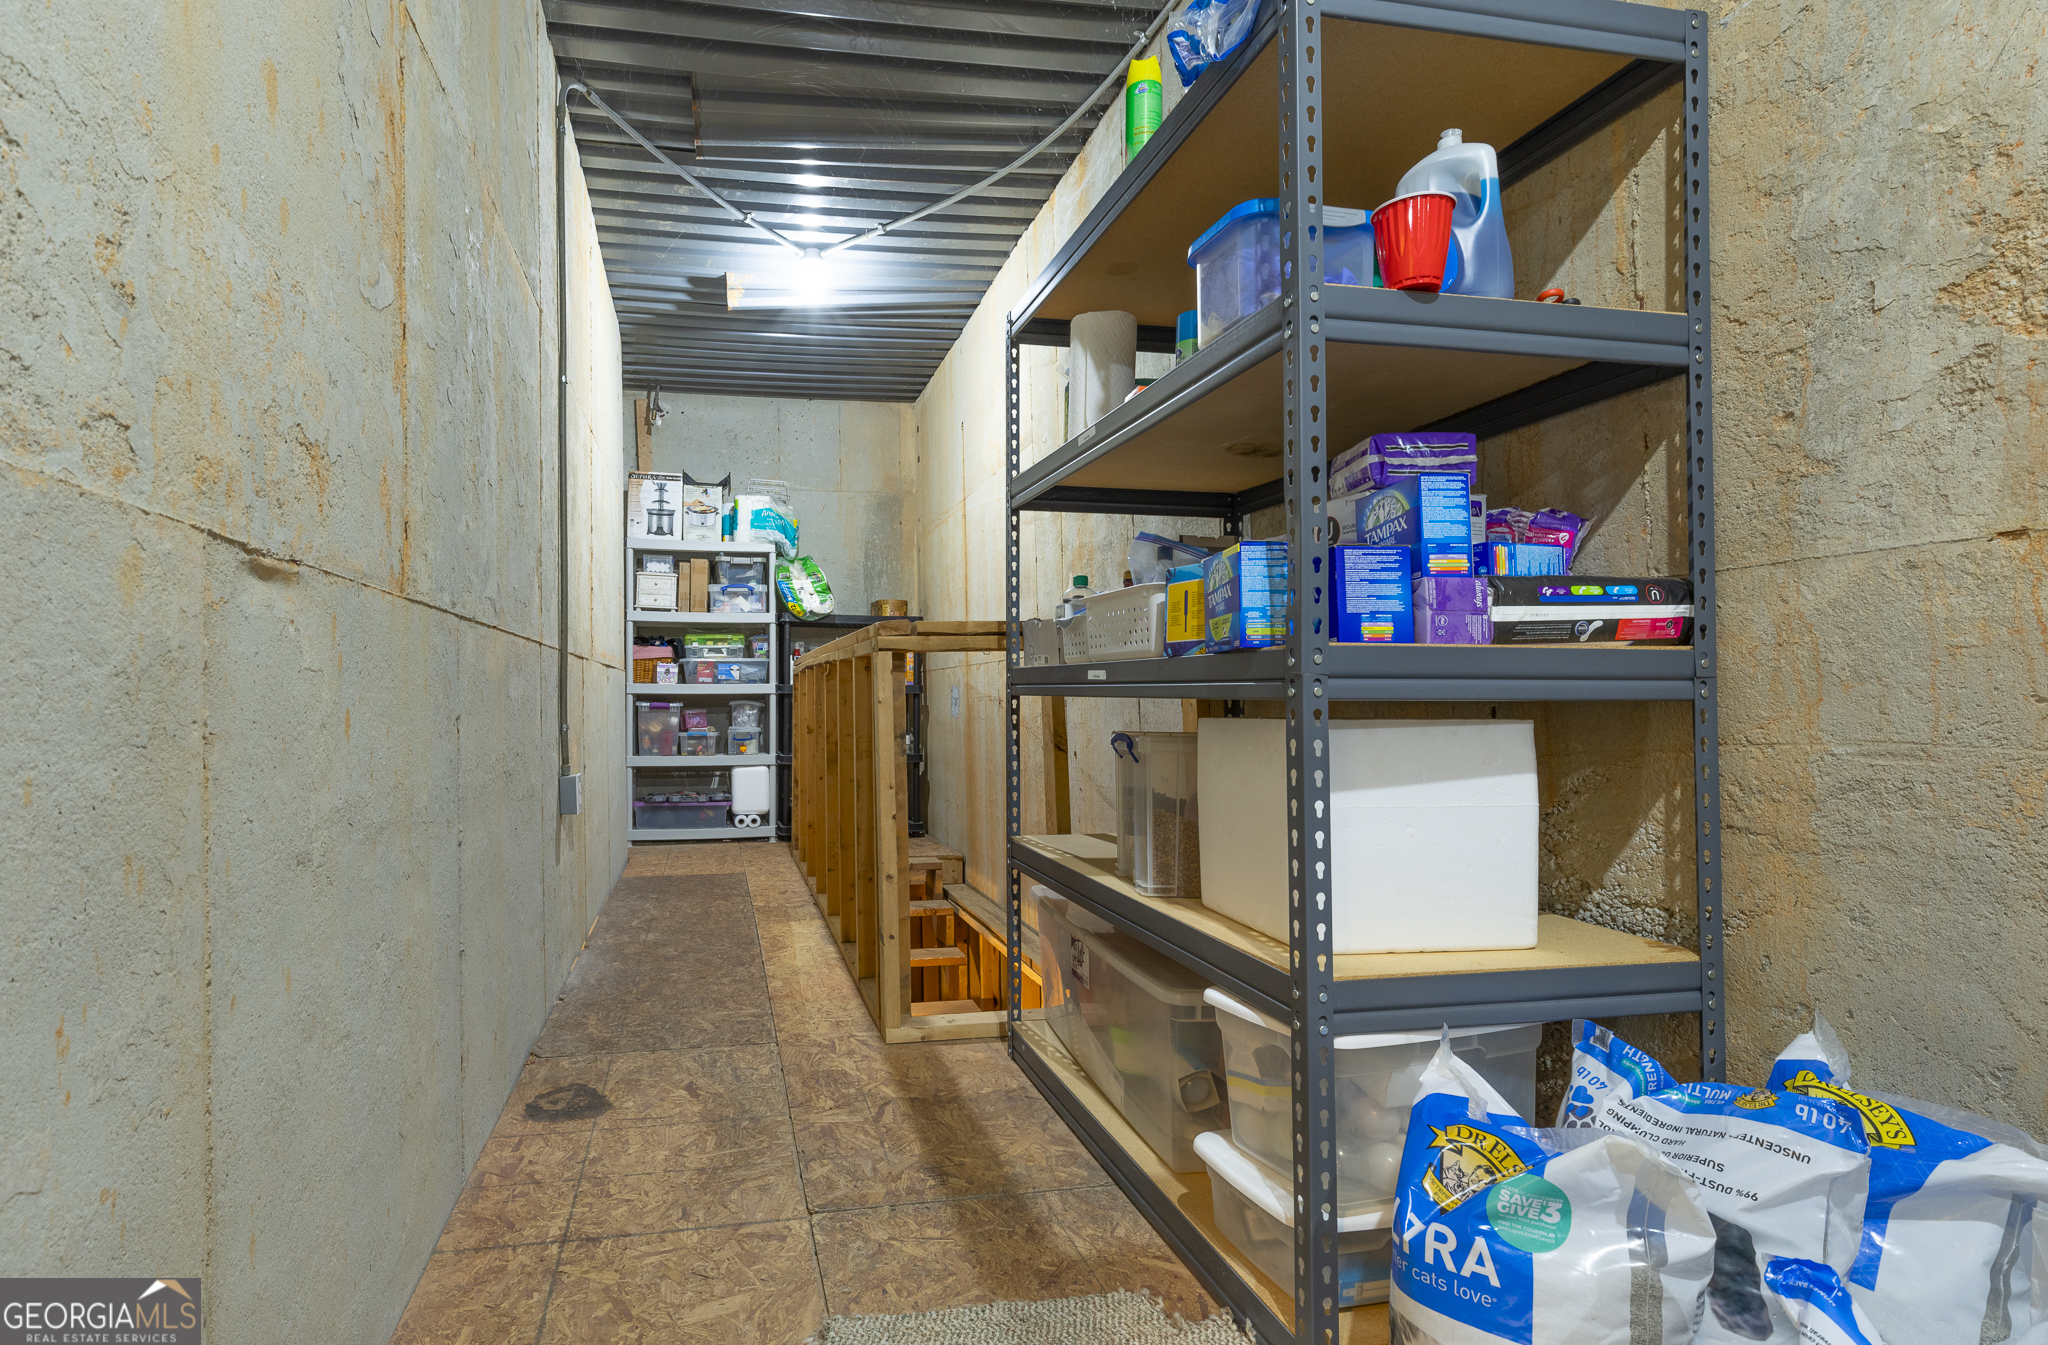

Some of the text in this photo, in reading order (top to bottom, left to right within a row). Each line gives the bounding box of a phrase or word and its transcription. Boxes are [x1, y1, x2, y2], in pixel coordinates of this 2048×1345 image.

[1364, 515, 1407, 545] TAMPAX
[1207, 583, 1232, 609] TAMPAX
[1473, 580, 1484, 608] always
[1577, 1066, 1591, 1079] lb
[1588, 1075, 1609, 1092] 40
[1606, 1107, 1660, 1143] CLUMPING
[1617, 1098, 1683, 1134] INGREDIENTS
[1795, 1104, 1852, 1133] 40 lb
[1661, 1136, 1687, 1146] HARD
[1685, 1126, 1727, 1139] NATURAL
[1672, 1151, 1725, 1173] SUPERIOR
[1498, 1188, 1543, 1209] SAVE
[1736, 1188, 1759, 1202] 99%
[1496, 1201, 1541, 1220] GIVE
[1498, 1219, 1511, 1227] FIND
[1512, 1222, 1522, 1230] THE
[1523, 1225, 1547, 1237] COUPON
[1412, 1266, 1447, 1292] cats
